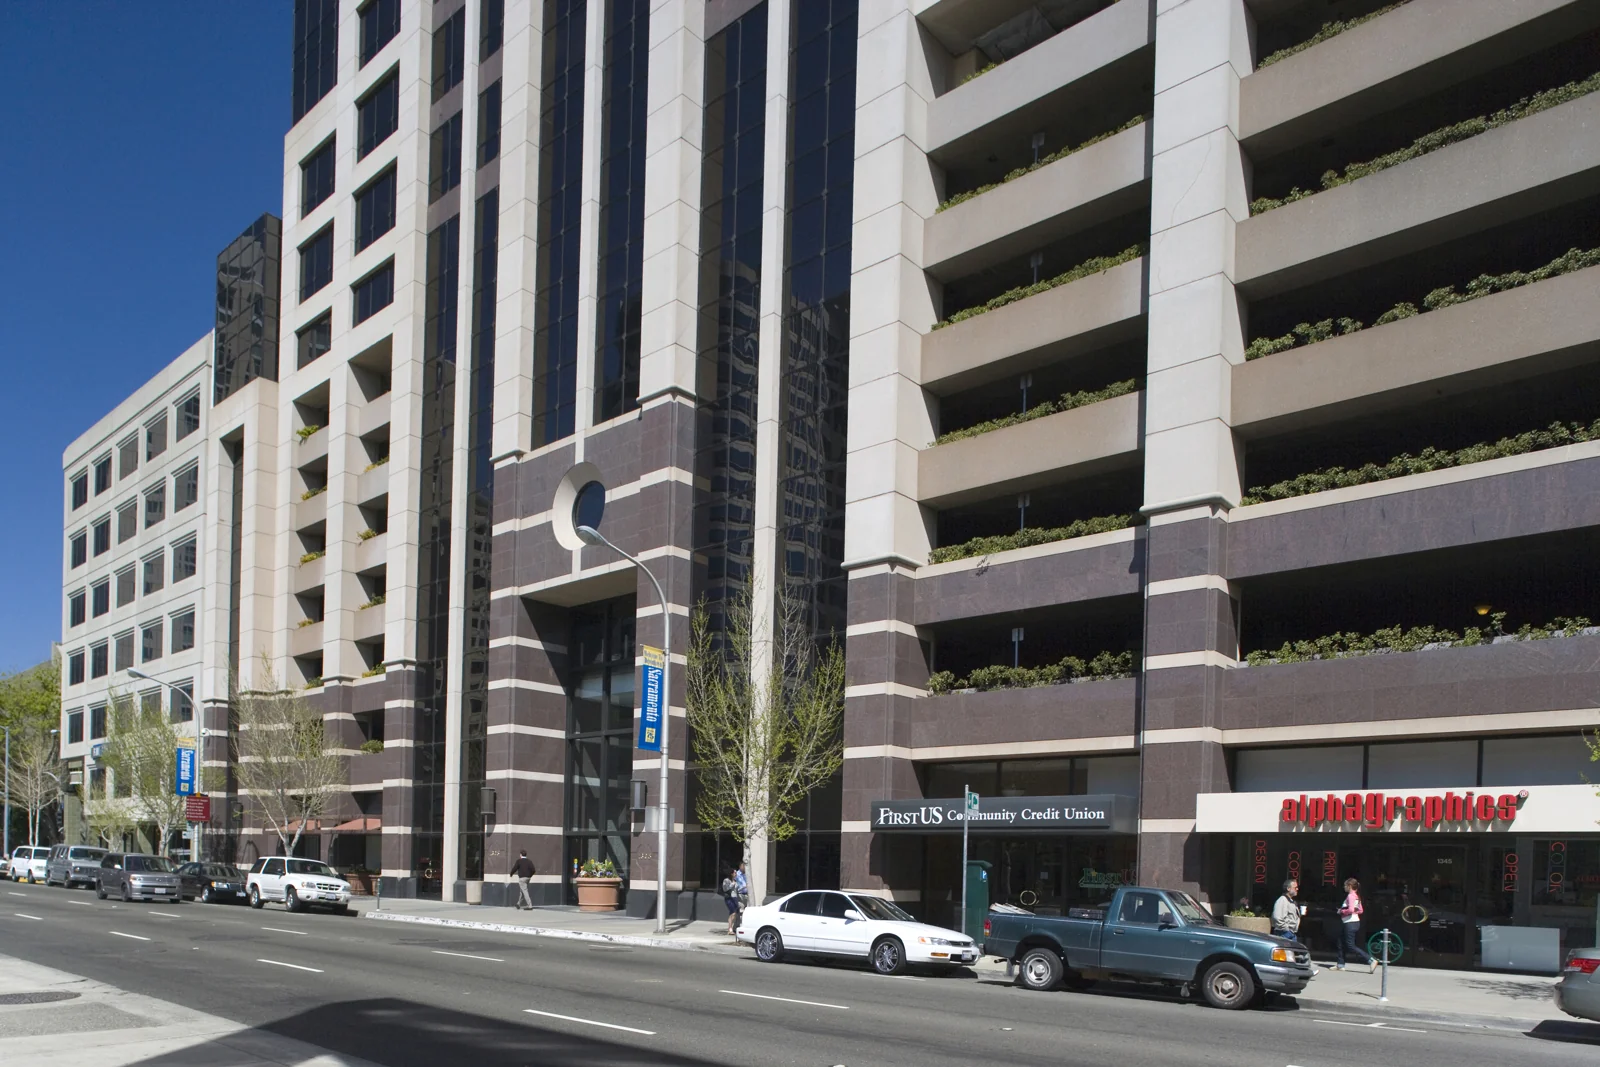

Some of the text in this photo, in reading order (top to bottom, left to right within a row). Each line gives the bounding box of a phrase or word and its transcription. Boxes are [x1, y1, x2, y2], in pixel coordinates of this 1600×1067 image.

[646, 667, 662, 722] Sacramento
[947, 809, 1017, 823] Comunity
[1021, 808, 1060, 820] Credit
[1064, 807, 1105, 820] Union
[1282, 791, 1517, 829] alphagraphics
[1288, 851, 1300, 880] COP
[1323, 851, 1336, 886] PRINT
[1504, 853, 1519, 891] OPEN
